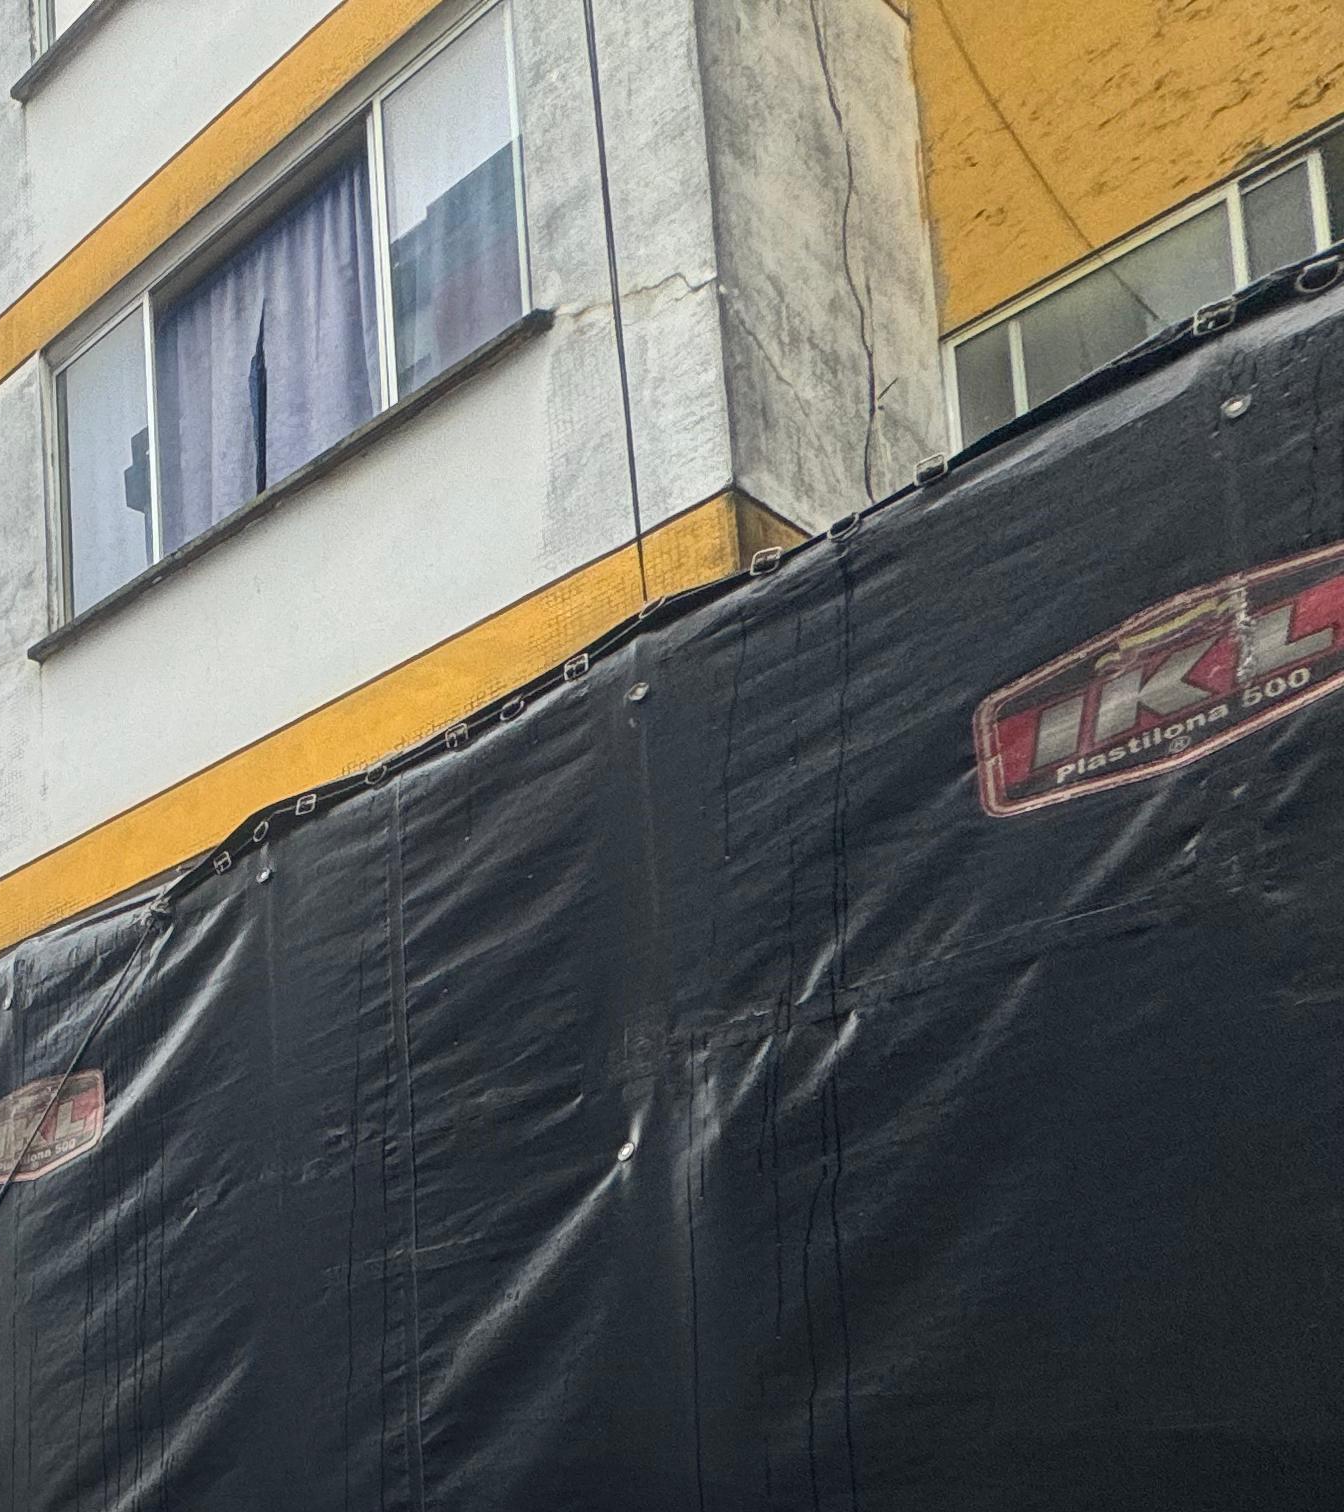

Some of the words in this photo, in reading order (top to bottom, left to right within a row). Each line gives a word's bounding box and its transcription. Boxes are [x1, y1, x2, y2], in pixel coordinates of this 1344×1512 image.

[1030, 605, 1334, 771] IKL
[1056, 703, 1231, 784] Plastilona
[1241, 665, 1312, 709] 500
